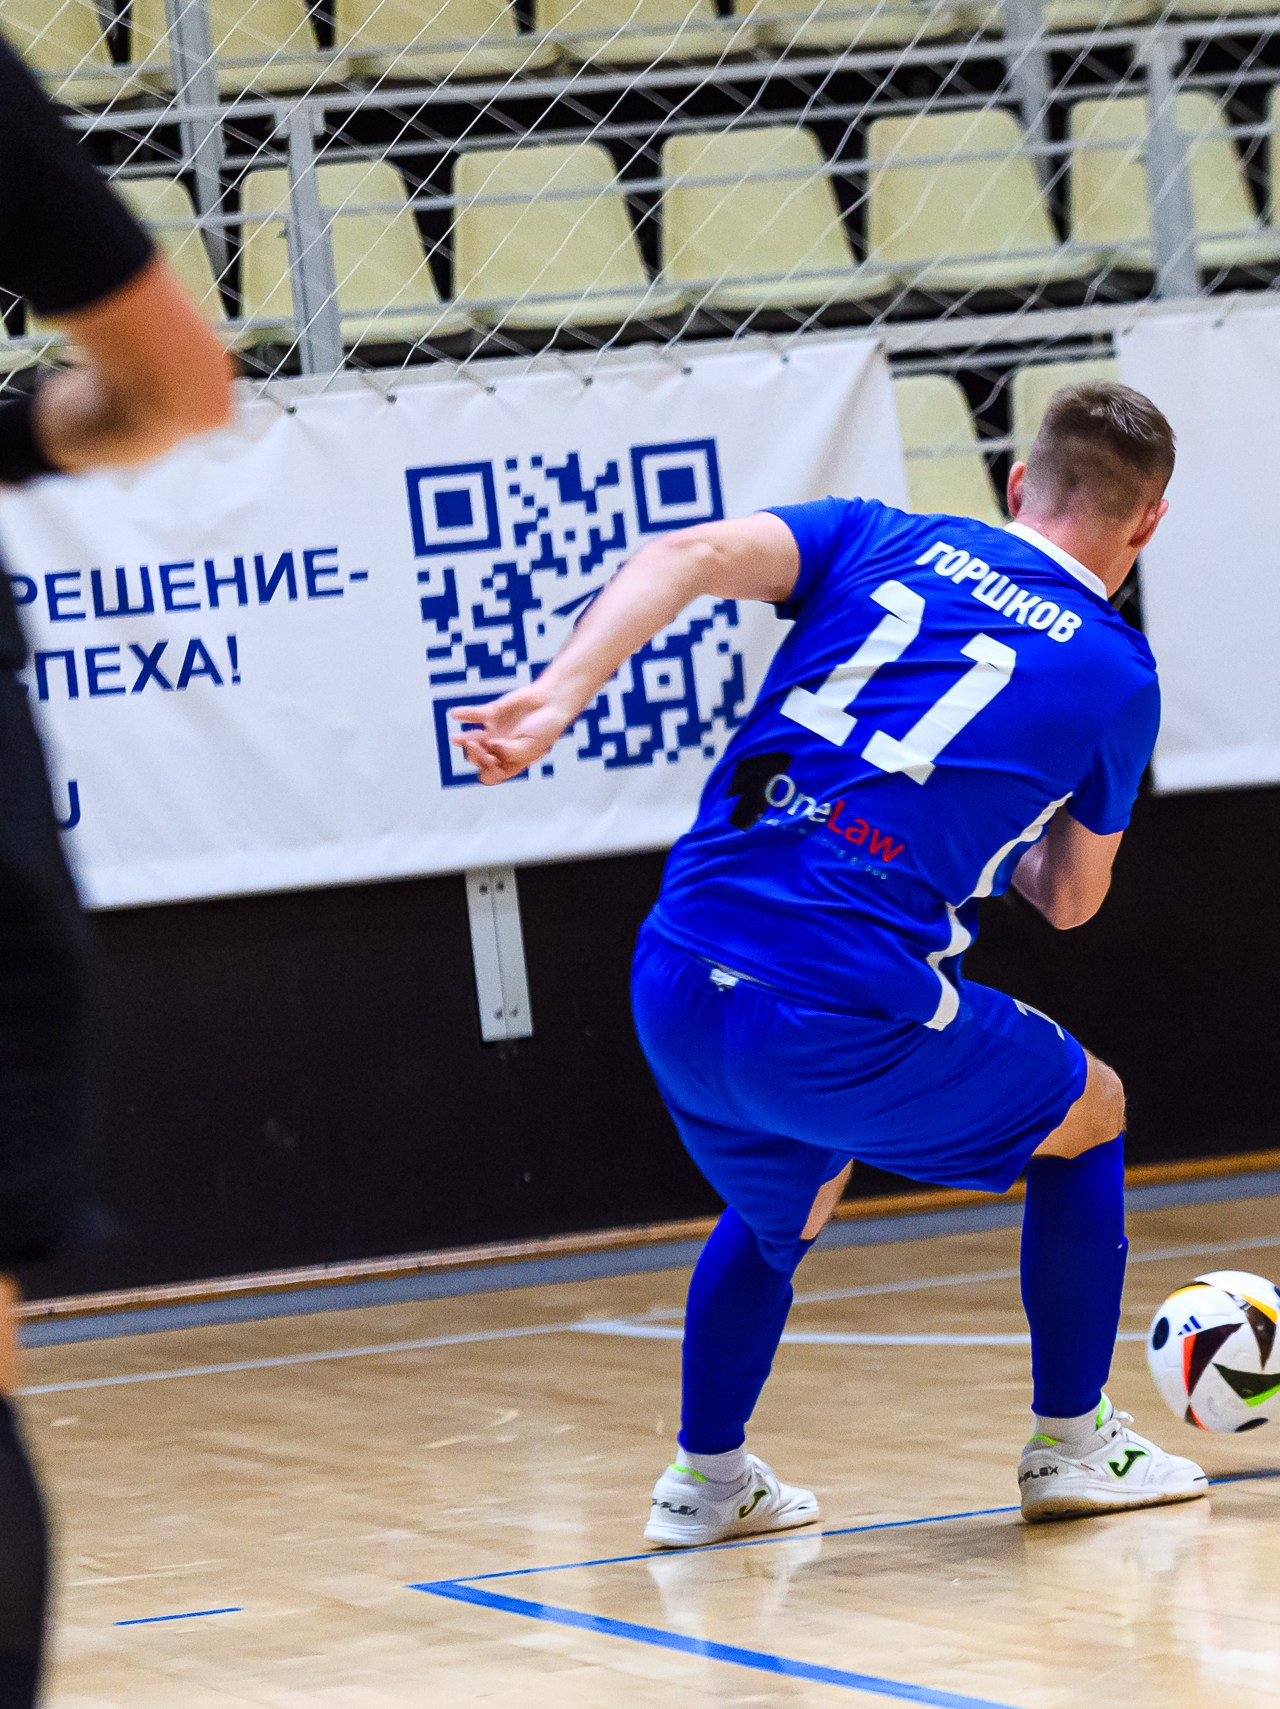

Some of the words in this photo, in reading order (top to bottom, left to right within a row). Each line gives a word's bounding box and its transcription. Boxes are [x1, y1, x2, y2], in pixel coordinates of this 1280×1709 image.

[914, 540, 1083, 643] ГОРШКОВ
[30, 633, 242, 701] ПЕХА!
[779, 579, 1017, 786] 11
[764, 773, 905, 863] OneLaw
